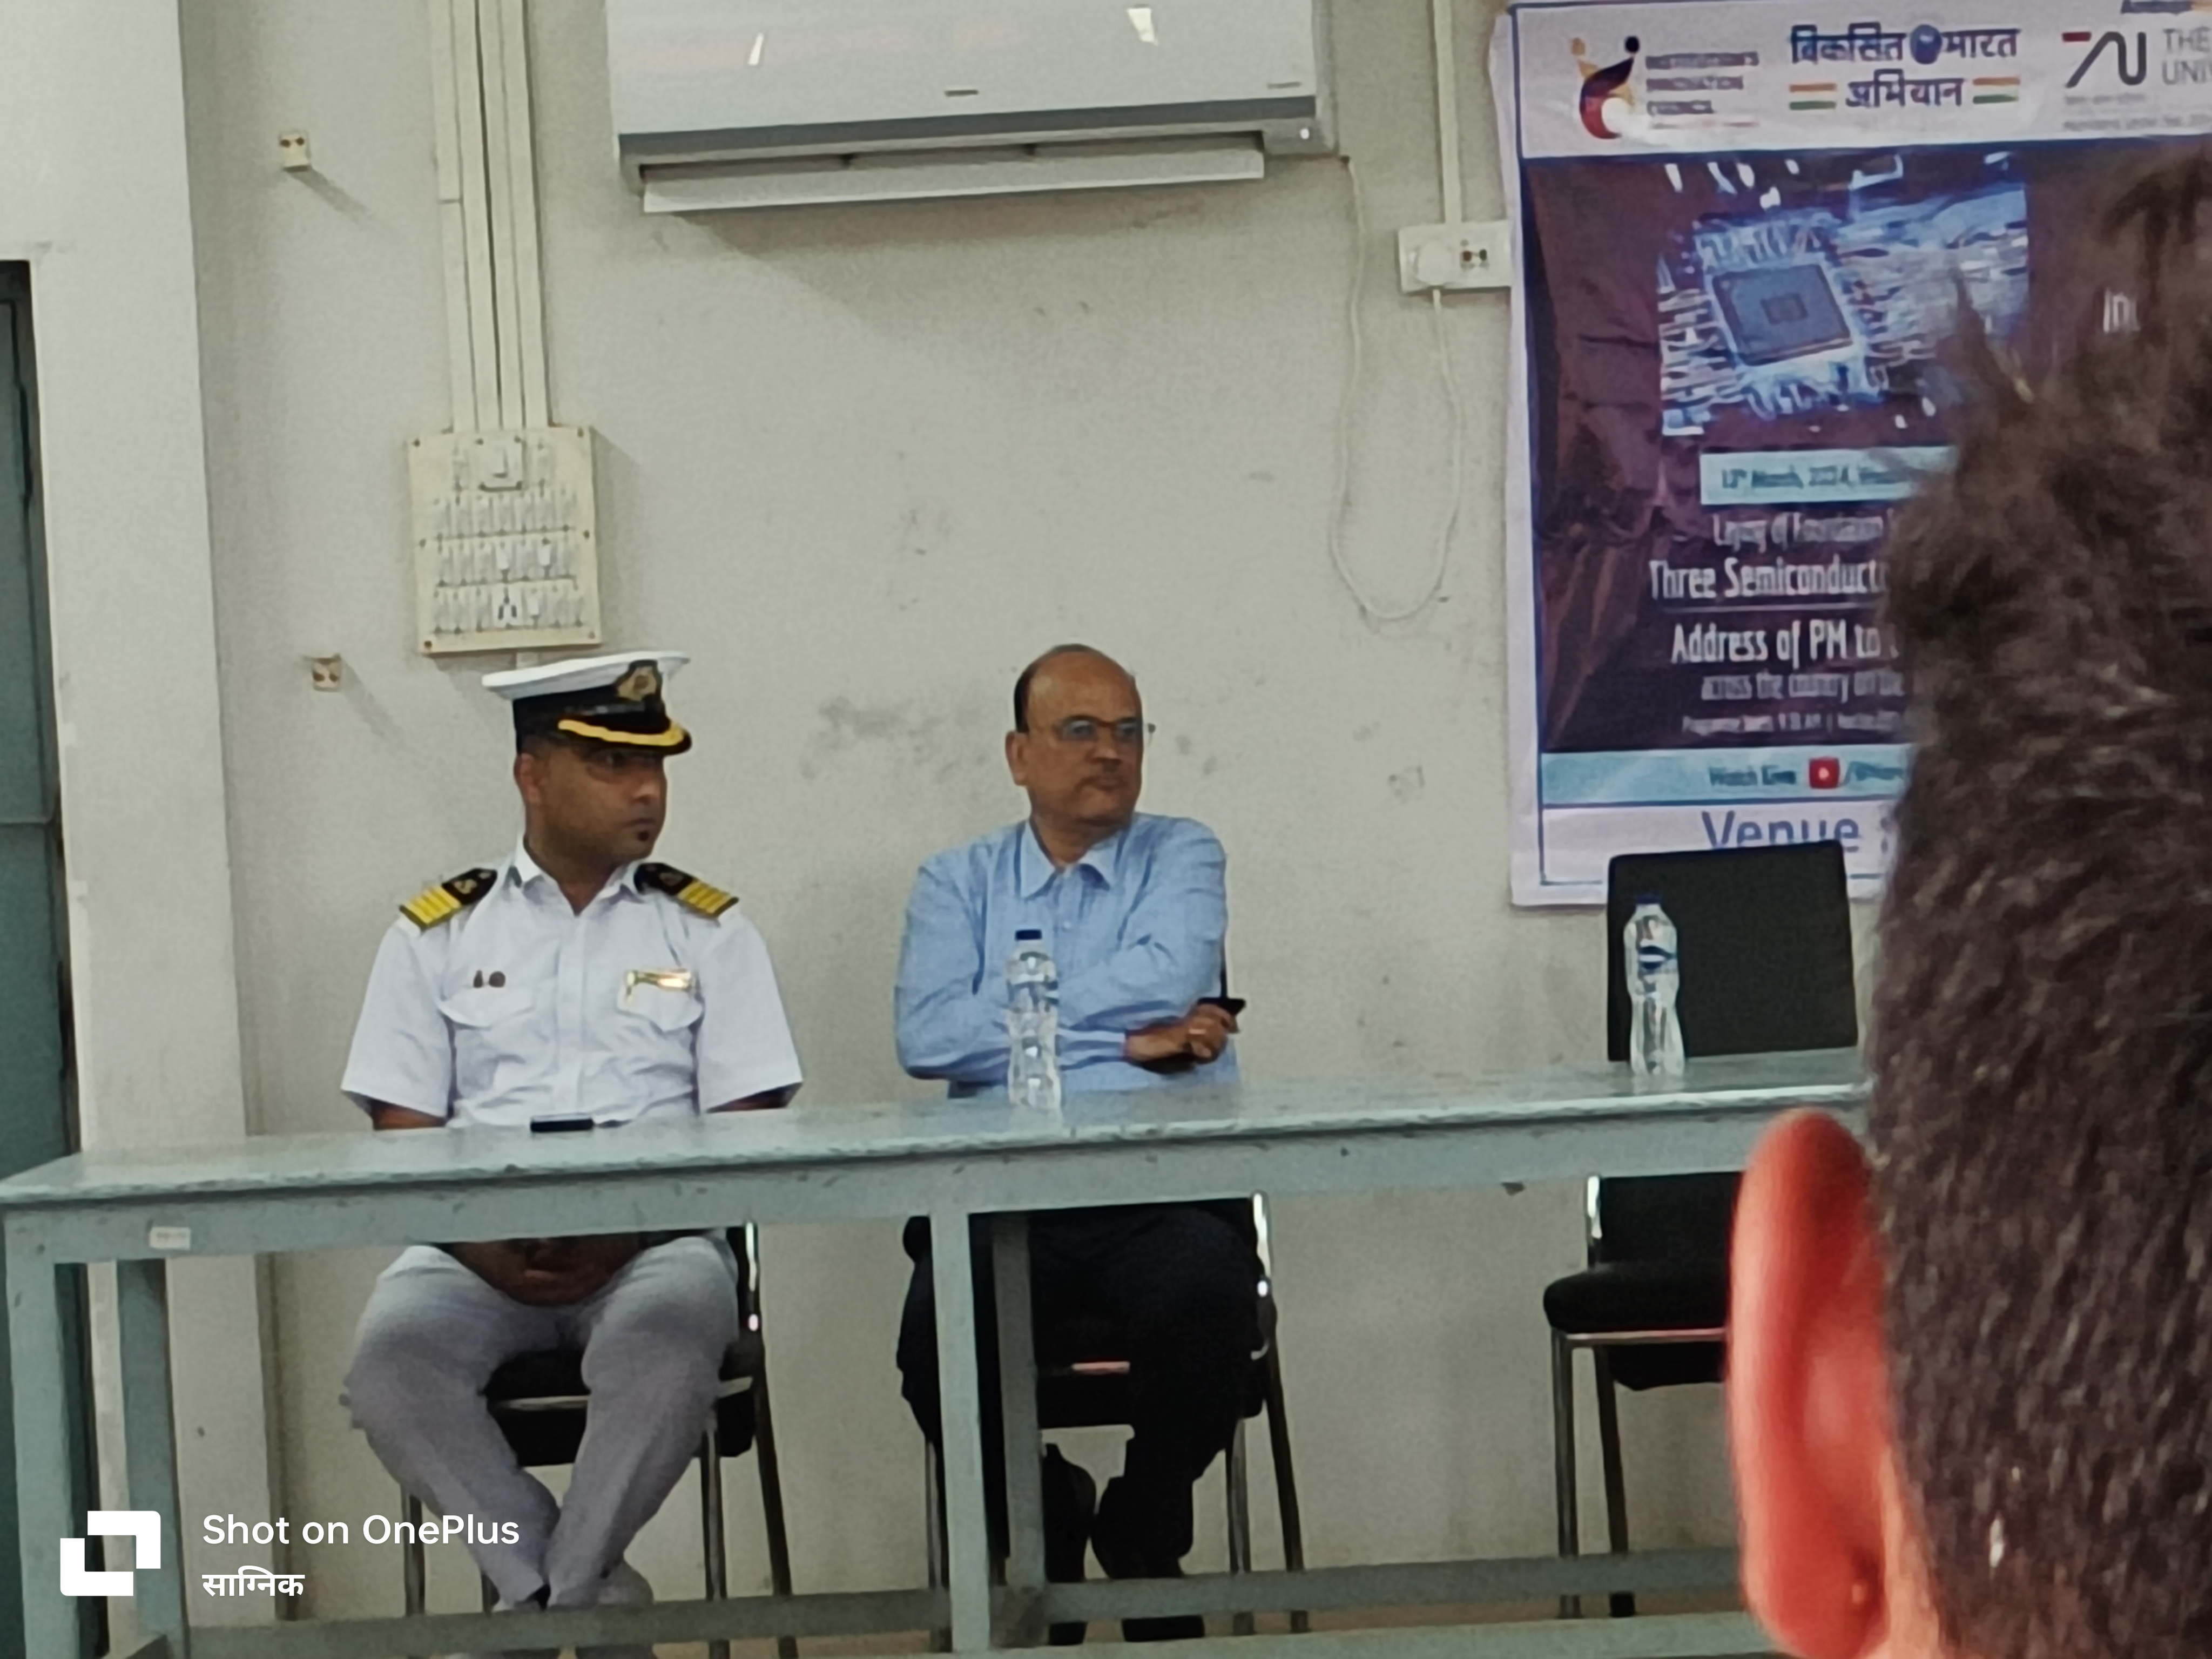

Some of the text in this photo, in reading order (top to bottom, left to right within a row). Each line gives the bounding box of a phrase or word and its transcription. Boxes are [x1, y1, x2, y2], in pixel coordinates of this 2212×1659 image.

[2162, 26, 2211, 53] THE
[2162, 59, 2212, 85] UNI
[1649, 559, 1717, 600] Three
[1671, 619, 1882, 670] Address of PM to
[1702, 809, 1859, 853] Venue
